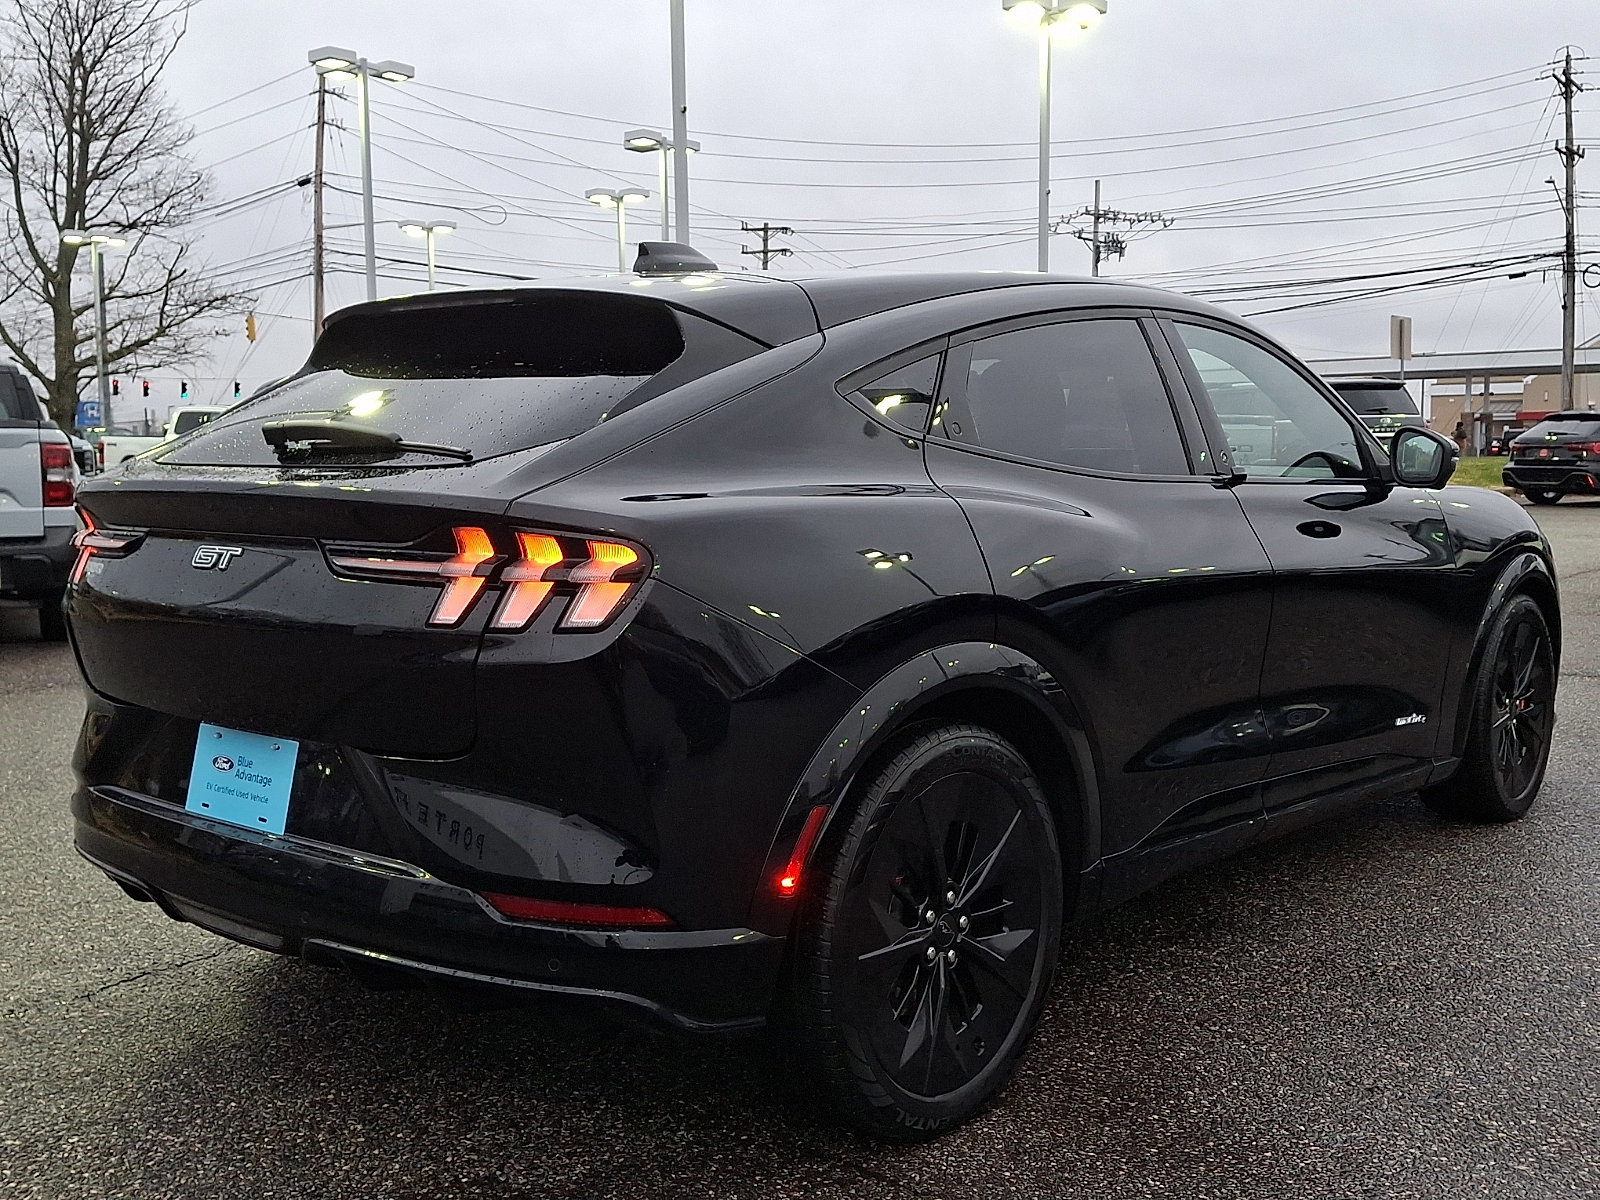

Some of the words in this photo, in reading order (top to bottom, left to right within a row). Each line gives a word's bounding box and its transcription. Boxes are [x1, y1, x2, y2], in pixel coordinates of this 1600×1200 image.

[191, 544, 243, 569] GT
[237, 755, 254, 769] Blue
[234, 768, 273, 787] Advantage
[206, 782, 214, 790] EV
[214, 784, 235, 795] Certified
[235, 788, 249, 800] Used
[250, 792, 269, 804] Vehicle
